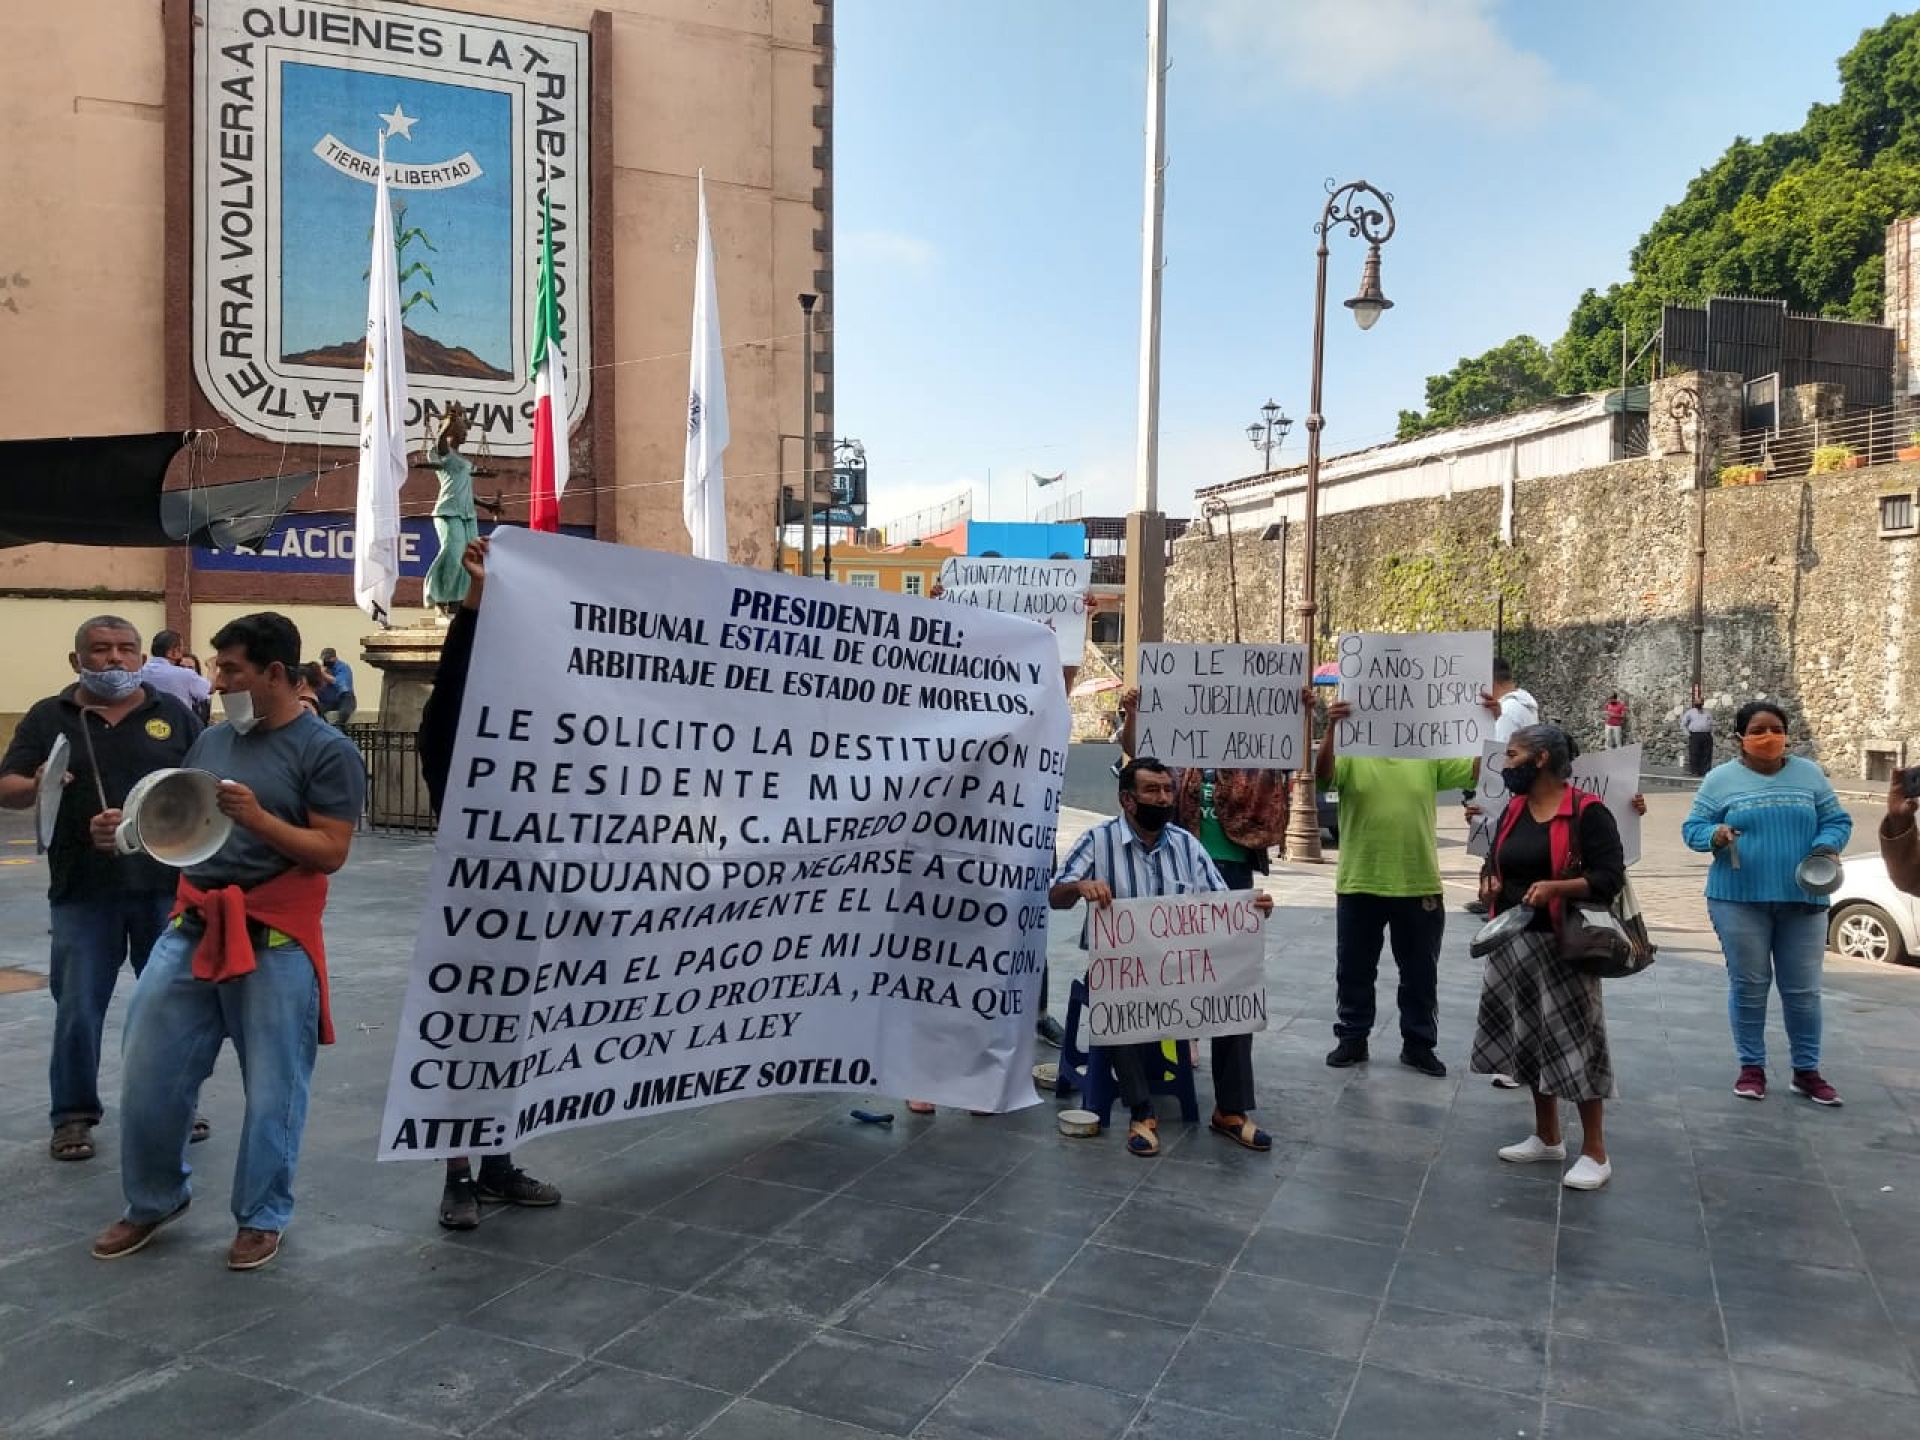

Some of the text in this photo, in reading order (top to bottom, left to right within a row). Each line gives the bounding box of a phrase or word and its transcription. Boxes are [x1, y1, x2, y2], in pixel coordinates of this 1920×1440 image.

[221, 42, 254, 69] A
[242, 8, 443, 57] QUIENES
[459, 33, 512, 71] LA
[221, 73, 254, 261] VOLVERA
[326, 142, 471, 184] TIERRA LIBERTAD
[221, 272, 297, 419] TIERRA
[944, 558, 1077, 587] AYUNTAMIENTO
[731, 587, 965, 648] PRESIDENTA DEL:
[1013, 591, 1067, 614] LAUDO
[570, 601, 1041, 685] TRIBUNAL ESTATAL DE CONCILIACIÓN Y
[1140, 649, 1303, 676] NO LE ROBEN
[1339, 635, 1464, 680] 8 AÑOS DE
[567, 647, 1034, 716] ARBITRAJE DEL ESTADO DE MORELOS.
[1137, 684, 1299, 717] LA JUBILACION
[477, 706, 1064, 776] LE SOLICITO LA DESTITUCIÓN DEL
[1138, 728, 1293, 761] A MI ABUELO
[1339, 719, 1478, 748] DEL DECRETO
[467, 757, 1060, 813] PRESIDENTE MUNICIPAL DE
[462, 808, 728, 850] TLALTIZAPAN,
[740, 816, 770, 844] C.
[782, 811, 907, 843] ALFREDO
[447, 850, 1050, 893] MANDUJANO POR NEGARSE A CUMPLIR
[443, 888, 1046, 941] VOLUNTARIAMENTE EL LAUDO QUE
[1094, 900, 1260, 950] NO QUEREMOS
[428, 959, 607, 996] ORDENA
[623, 955, 661, 985] EL
[675, 940, 763, 976] PAGO
[772, 935, 812, 962] DE
[821, 933, 861, 957] MI
[1089, 948, 1216, 991] OTRA CITA
[419, 1010, 520, 1050] QUE
[527, 995, 648, 1040] NADIE
[652, 988, 701, 1018] LO
[705, 972, 842, 1010] PROTEJA
[868, 972, 961, 1008] PARA
[971, 987, 1022, 1020] QUE
[1089, 987, 1267, 1037] QUEREMOS SOLUCION
[410, 1012, 802, 1090] CUMPLA CON LA LEY
[392, 1057, 878, 1150] ATTE: MARIO JIMENEZ SOTELO.
